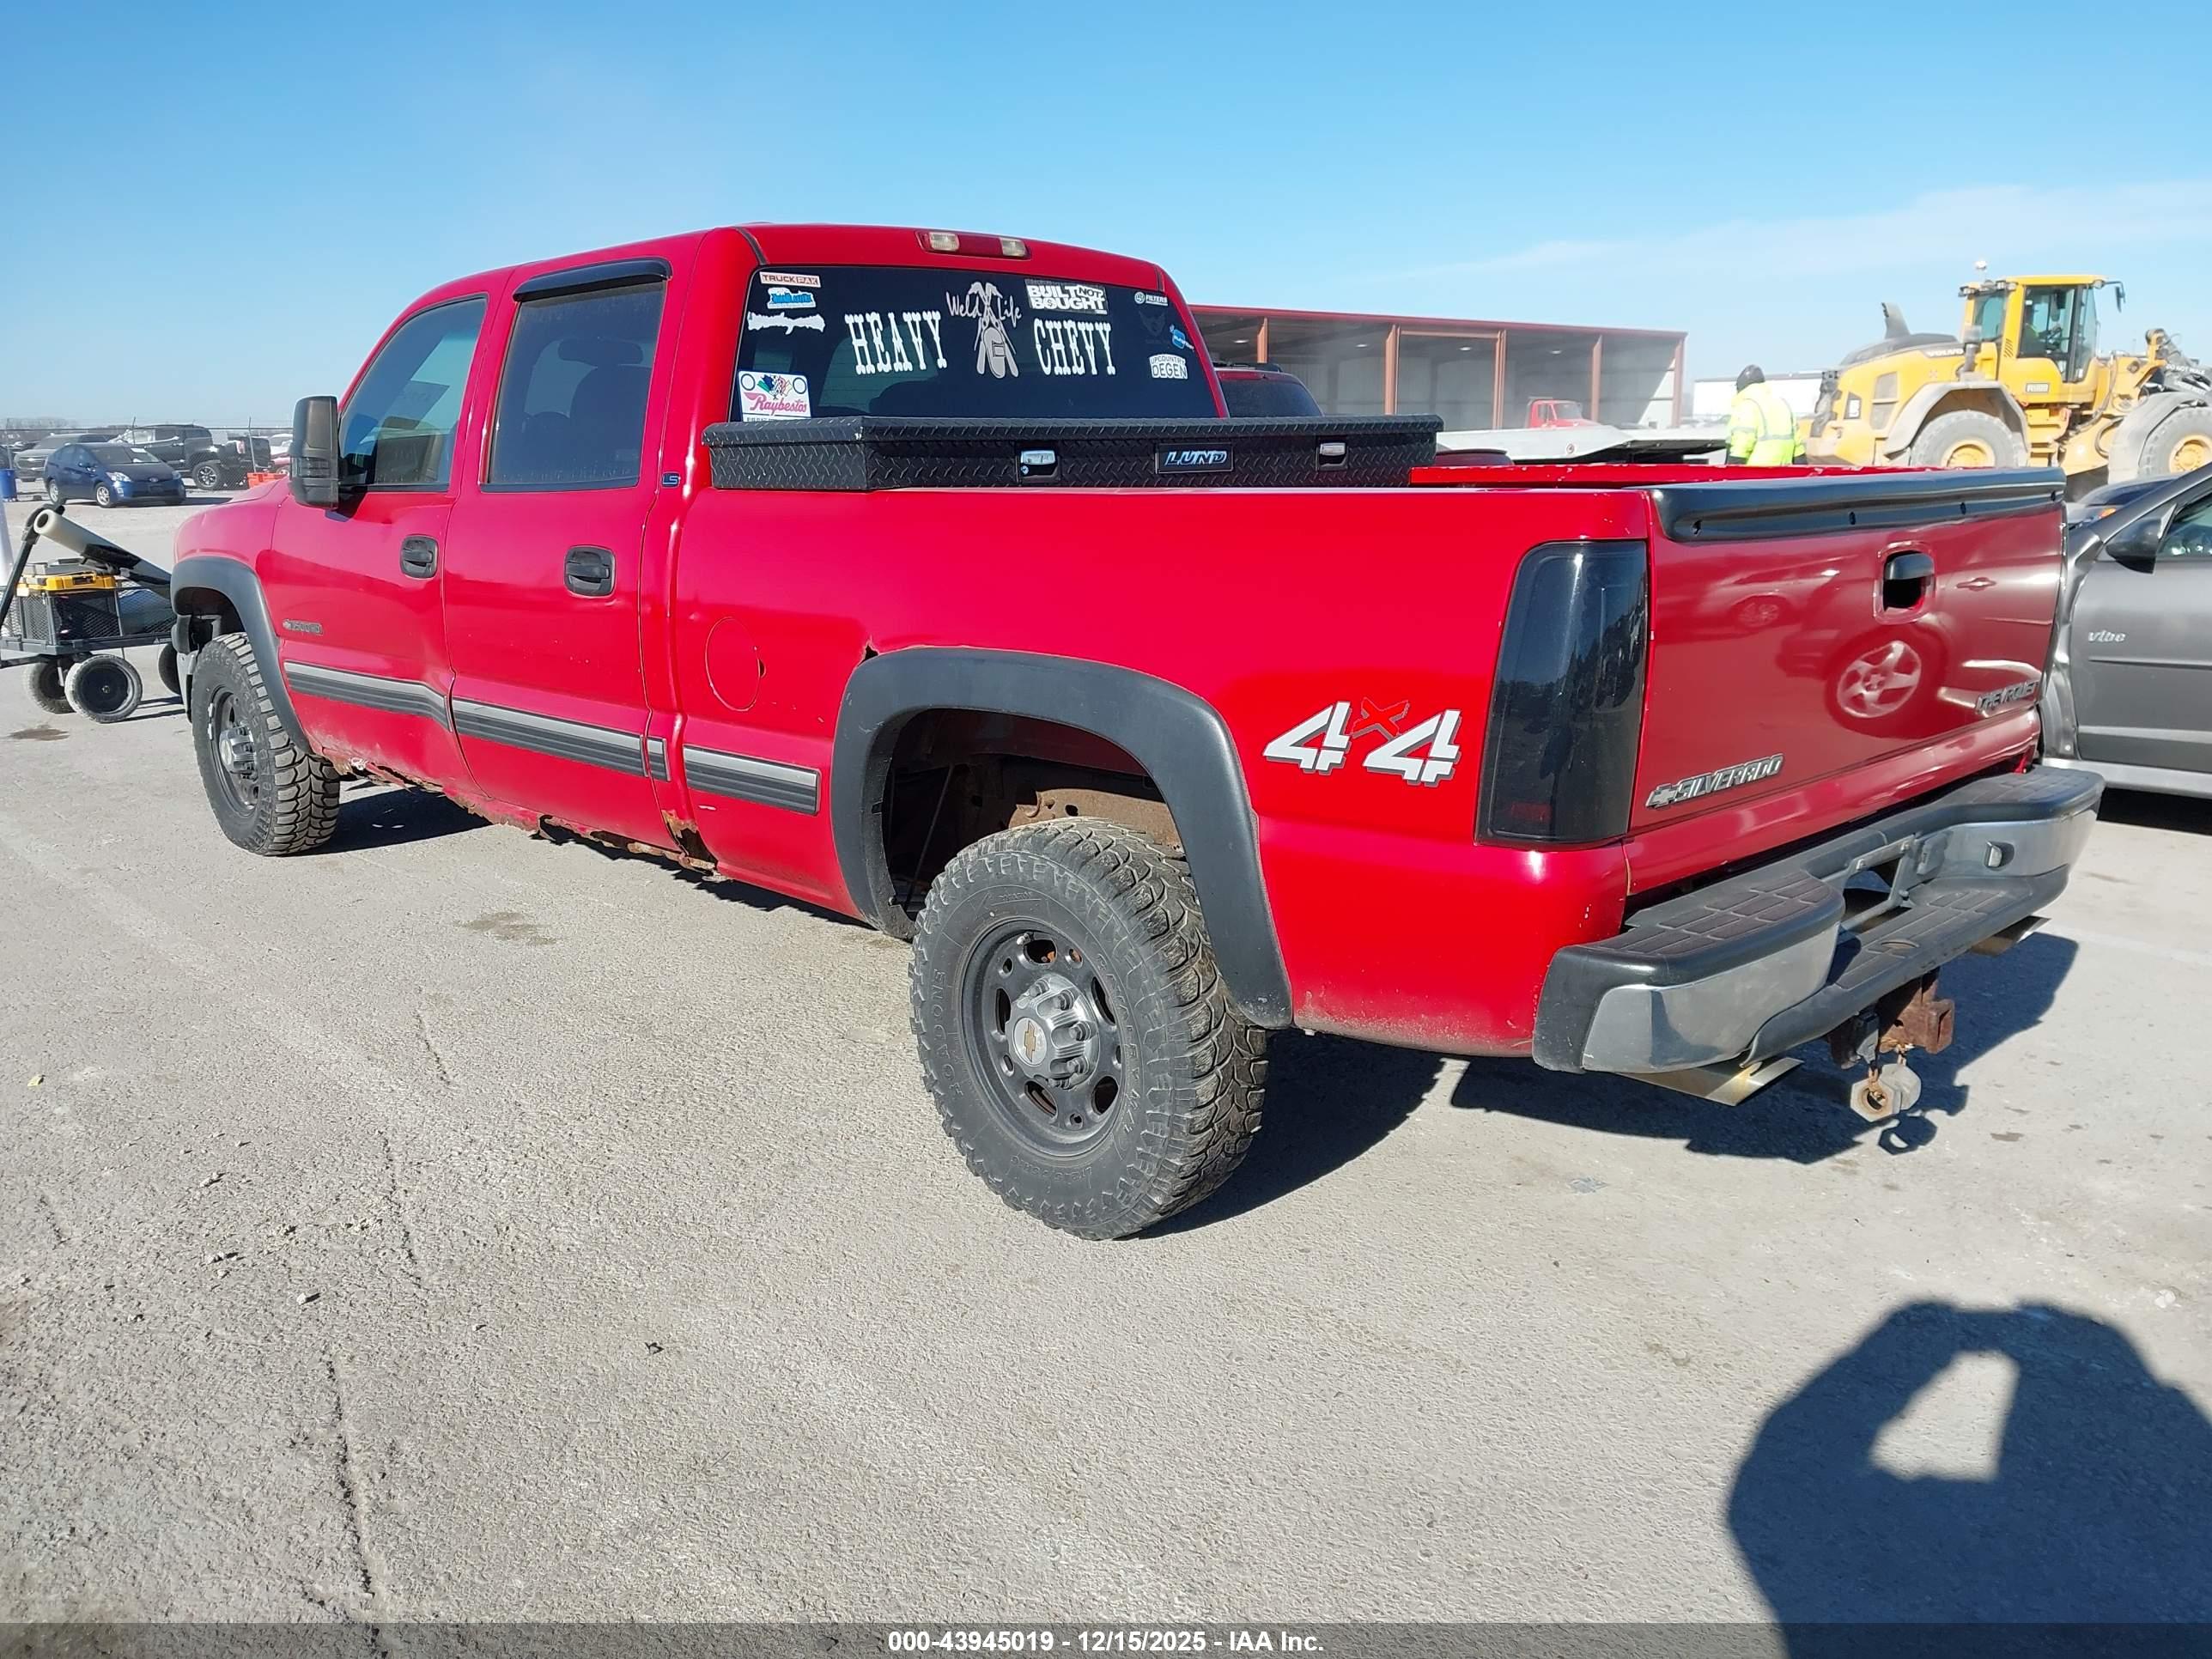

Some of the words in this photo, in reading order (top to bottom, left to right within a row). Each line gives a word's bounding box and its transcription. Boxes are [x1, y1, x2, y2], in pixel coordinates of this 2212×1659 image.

[1026, 285, 1078, 298] BUILT
[1079, 288, 1103, 298] NOT
[1145, 294, 1169, 303] FILTERS
[945, 291, 982, 318] Weld
[997, 295, 1022, 328] Life
[1030, 296, 1105, 310] BOUGHT
[844, 311, 947, 375] HEAVY
[1034, 318, 1116, 376] CHEVY
[1927, 348, 1964, 357] VOLVO
[1152, 363, 1188, 379] DEGEN
[744, 392, 807, 416] Raybestos
[1165, 449, 1228, 466] LUND
[662, 474, 678, 486] LS
[2087, 629, 2126, 642] vibe
[1674, 753, 1785, 802] SILVERADO
